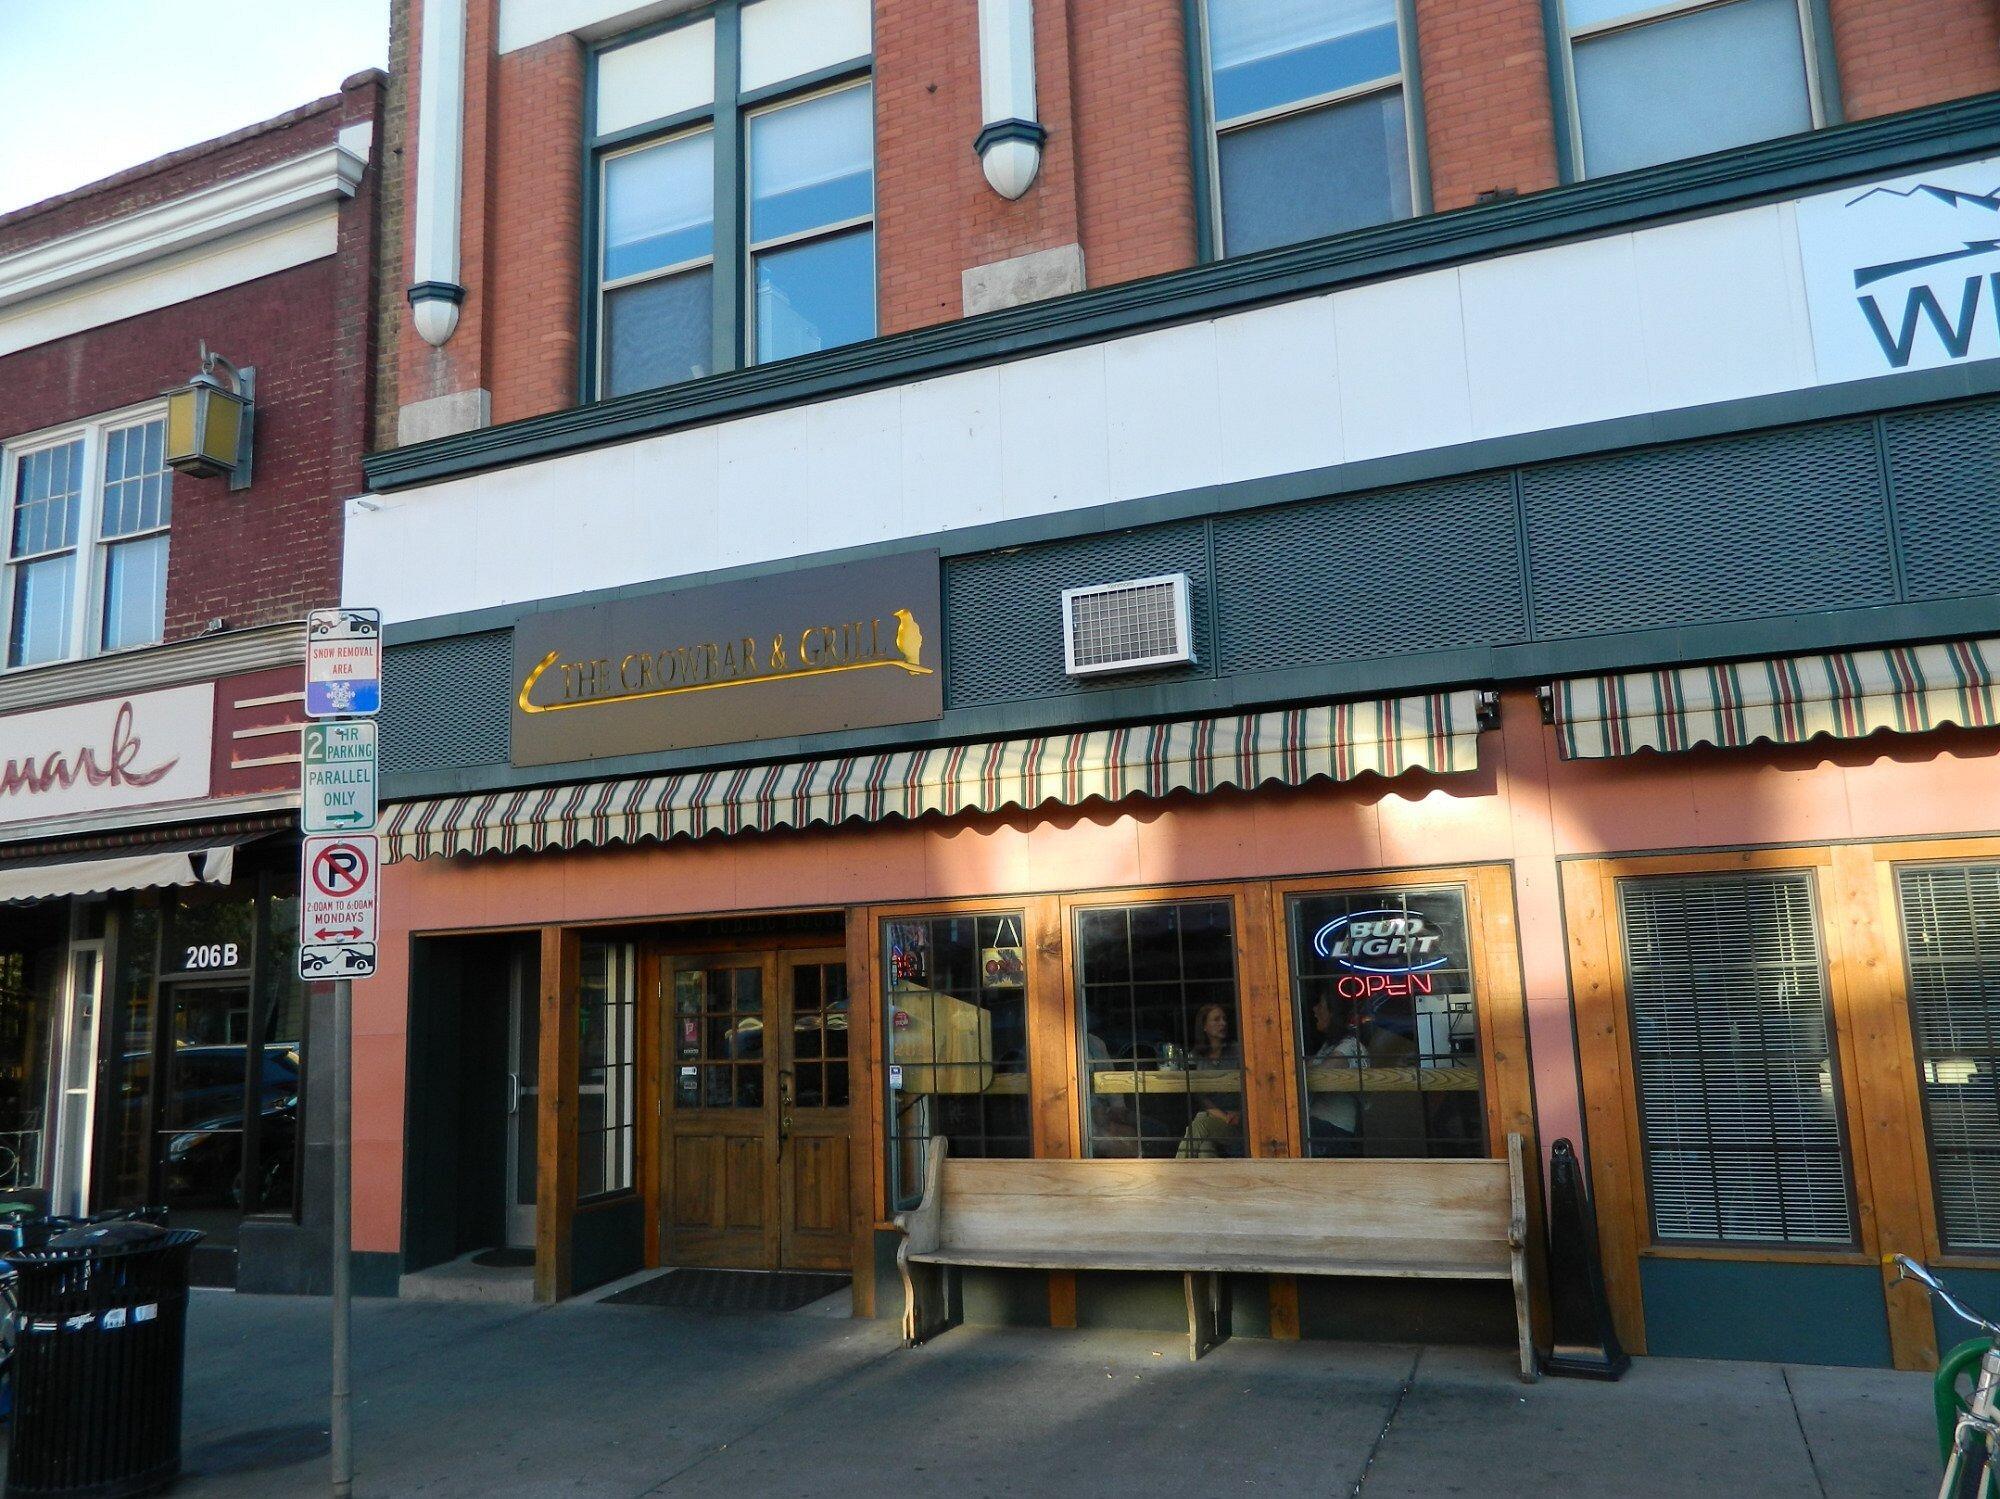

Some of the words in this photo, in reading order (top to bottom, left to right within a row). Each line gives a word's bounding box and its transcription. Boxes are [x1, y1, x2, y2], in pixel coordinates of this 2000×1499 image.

[313, 648, 335, 659] SNOW
[337, 646, 374, 658] REMOVAL
[560, 658, 611, 698] THE
[620, 637, 758, 690] CROWBAR
[771, 633, 788, 670] &
[800, 616, 887, 665] GRILL
[332, 664, 353, 674] AREA
[307, 731, 324, 759] 2
[339, 727, 359, 741] HR
[327, 743, 372, 759] PARKING
[309, 768, 371, 785] PARALLEL
[324, 791, 356, 806] ONLY
[307, 902, 333, 912] 2:00AM
[336, 901, 344, 911] TO
[347, 899, 374, 910] 6:00AM
[315, 912, 364, 924] MONDAYS
[1350, 918, 1423, 938] BUD
[1332, 935, 1440, 957] LIGHT
[1338, 972, 1432, 998] OPEN
